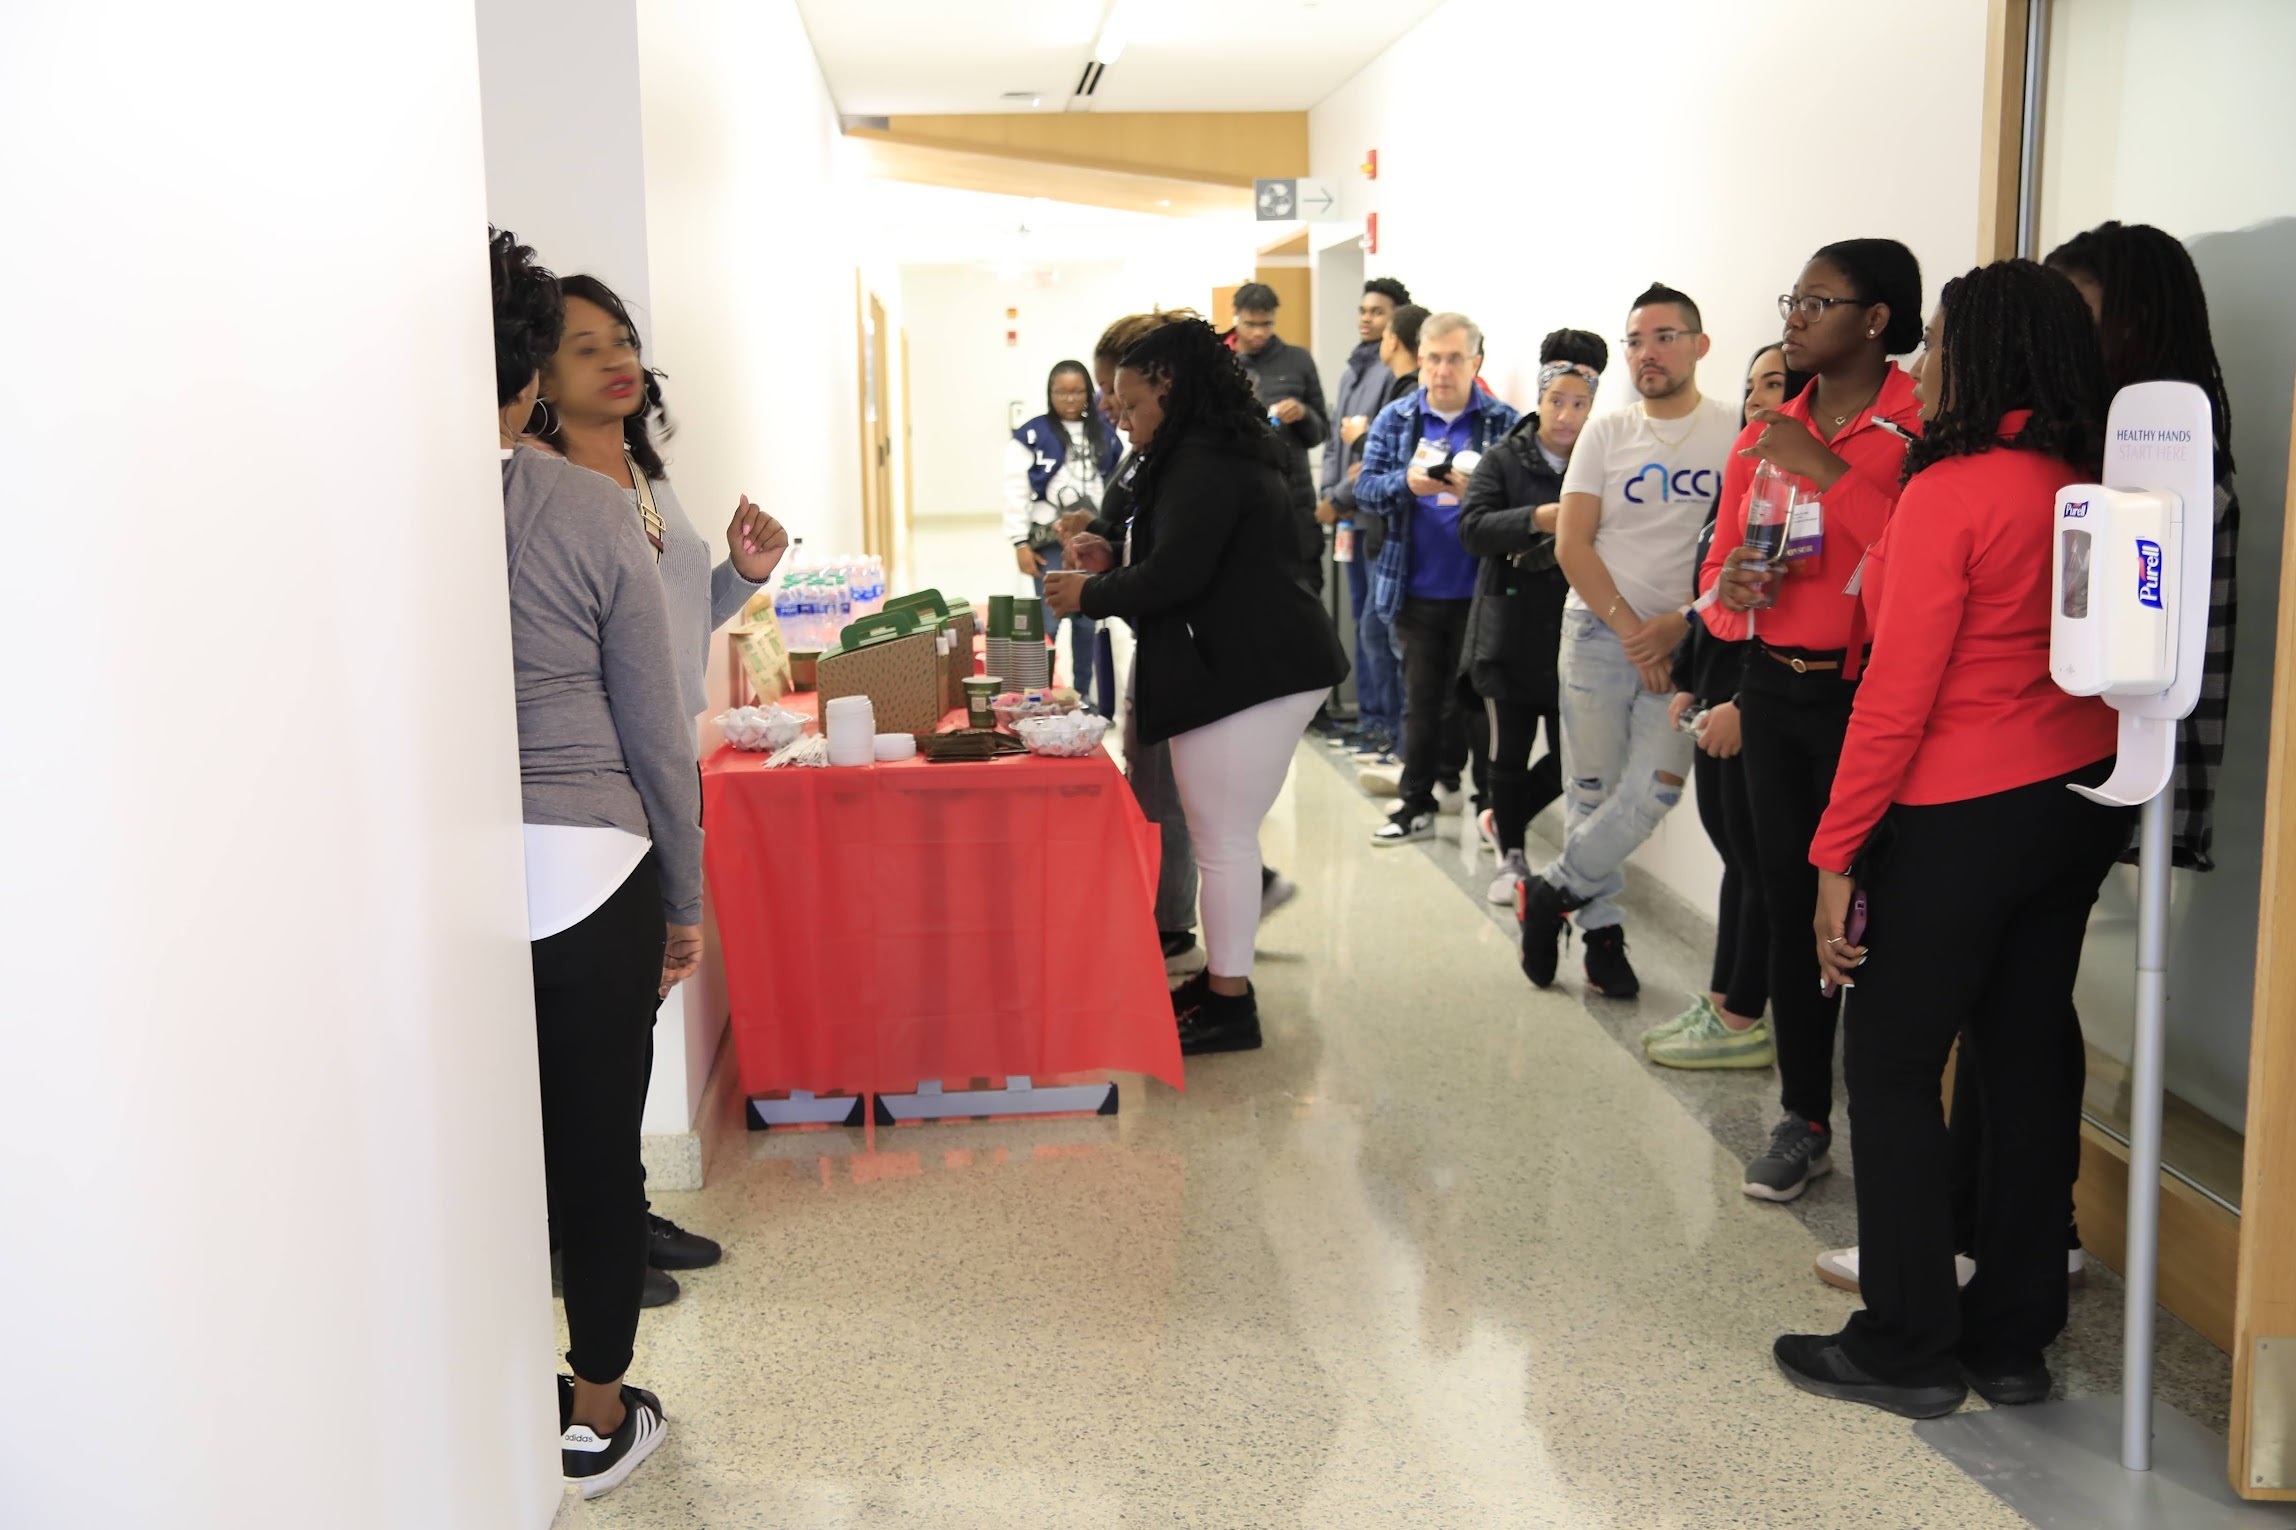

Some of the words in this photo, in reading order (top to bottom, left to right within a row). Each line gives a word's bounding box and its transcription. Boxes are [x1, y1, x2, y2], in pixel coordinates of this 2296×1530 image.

[2117, 429, 2156, 441] HEALTHY
[2158, 430, 2191, 442] HANDS
[2119, 444, 2152, 461] START
[2157, 445, 2187, 461] HERE
[2065, 503, 2086, 516] Purell
[2140, 545, 2159, 601] Purell
[564, 1434, 593, 1443] adidas
